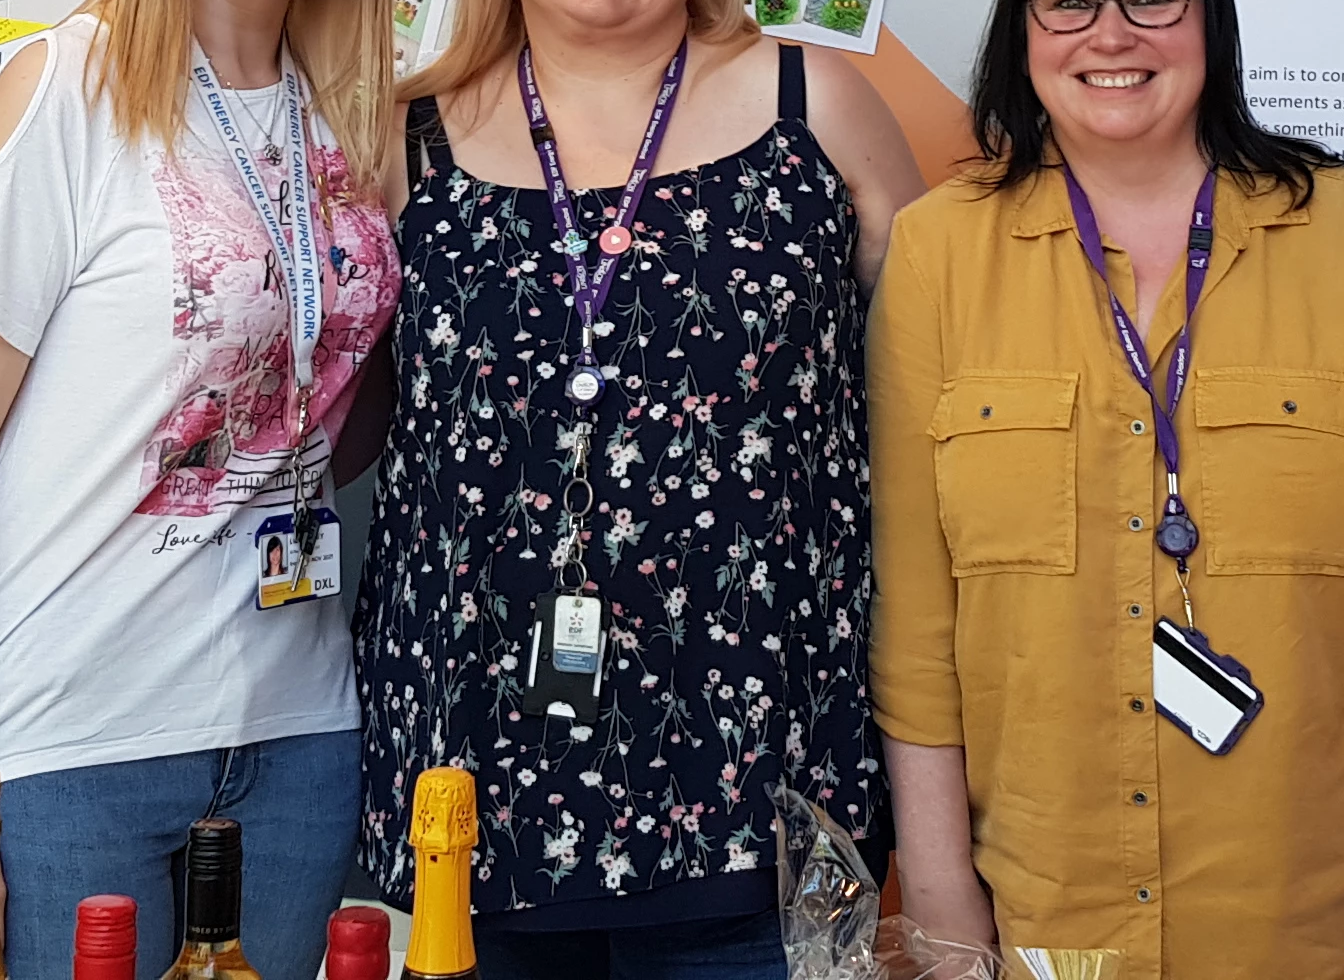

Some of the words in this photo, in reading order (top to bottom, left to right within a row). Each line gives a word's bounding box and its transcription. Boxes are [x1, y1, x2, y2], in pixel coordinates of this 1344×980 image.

[286, 73, 296, 97] EDF
[1248, 66, 1277, 80] aim
[1283, 66, 1294, 81] is
[1300, 69, 1316, 81] to
[1245, 93, 1329, 109] ievements
[288, 98, 302, 149] ENERGY
[292, 151, 305, 203] CANCER
[295, 205, 312, 264] SUPPORT
[302, 268, 316, 341] NETWORK
[314, 577, 335, 591] DXL
